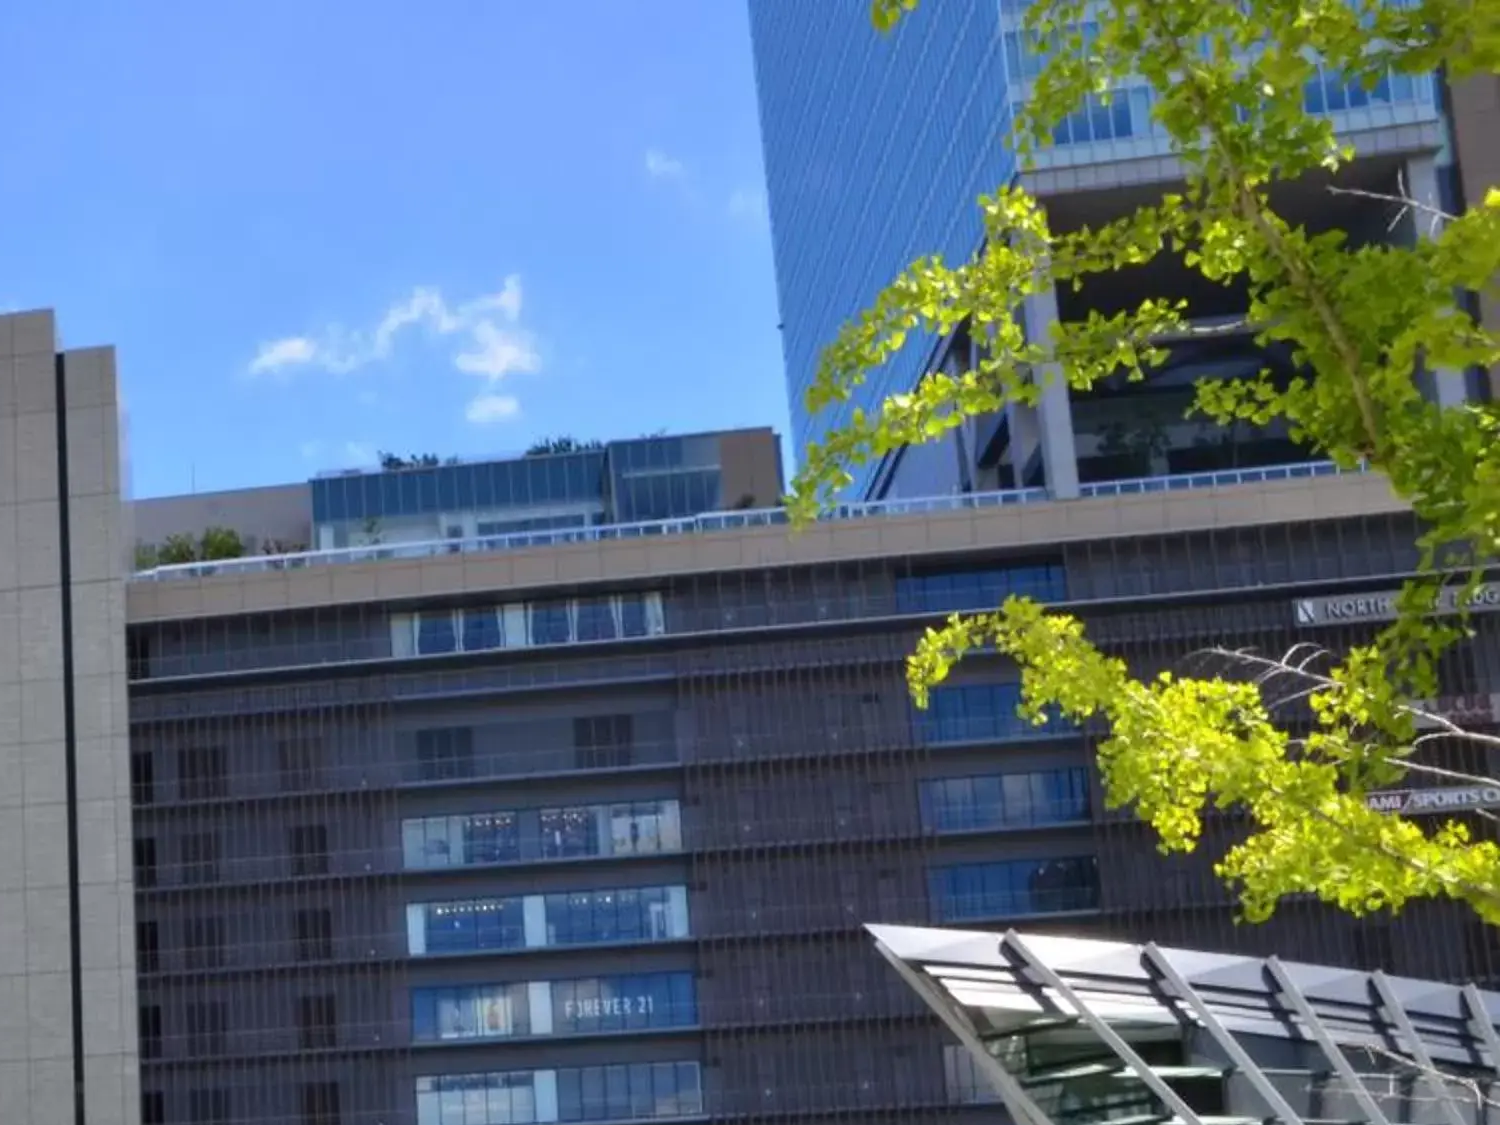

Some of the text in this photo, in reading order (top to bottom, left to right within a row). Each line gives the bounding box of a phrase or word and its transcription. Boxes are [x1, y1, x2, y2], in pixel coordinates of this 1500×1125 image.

[1324, 598, 1387, 620] NORTH
[1366, 795, 1402, 809] AMI
[565, 995, 653, 1019] FOREVER 21
